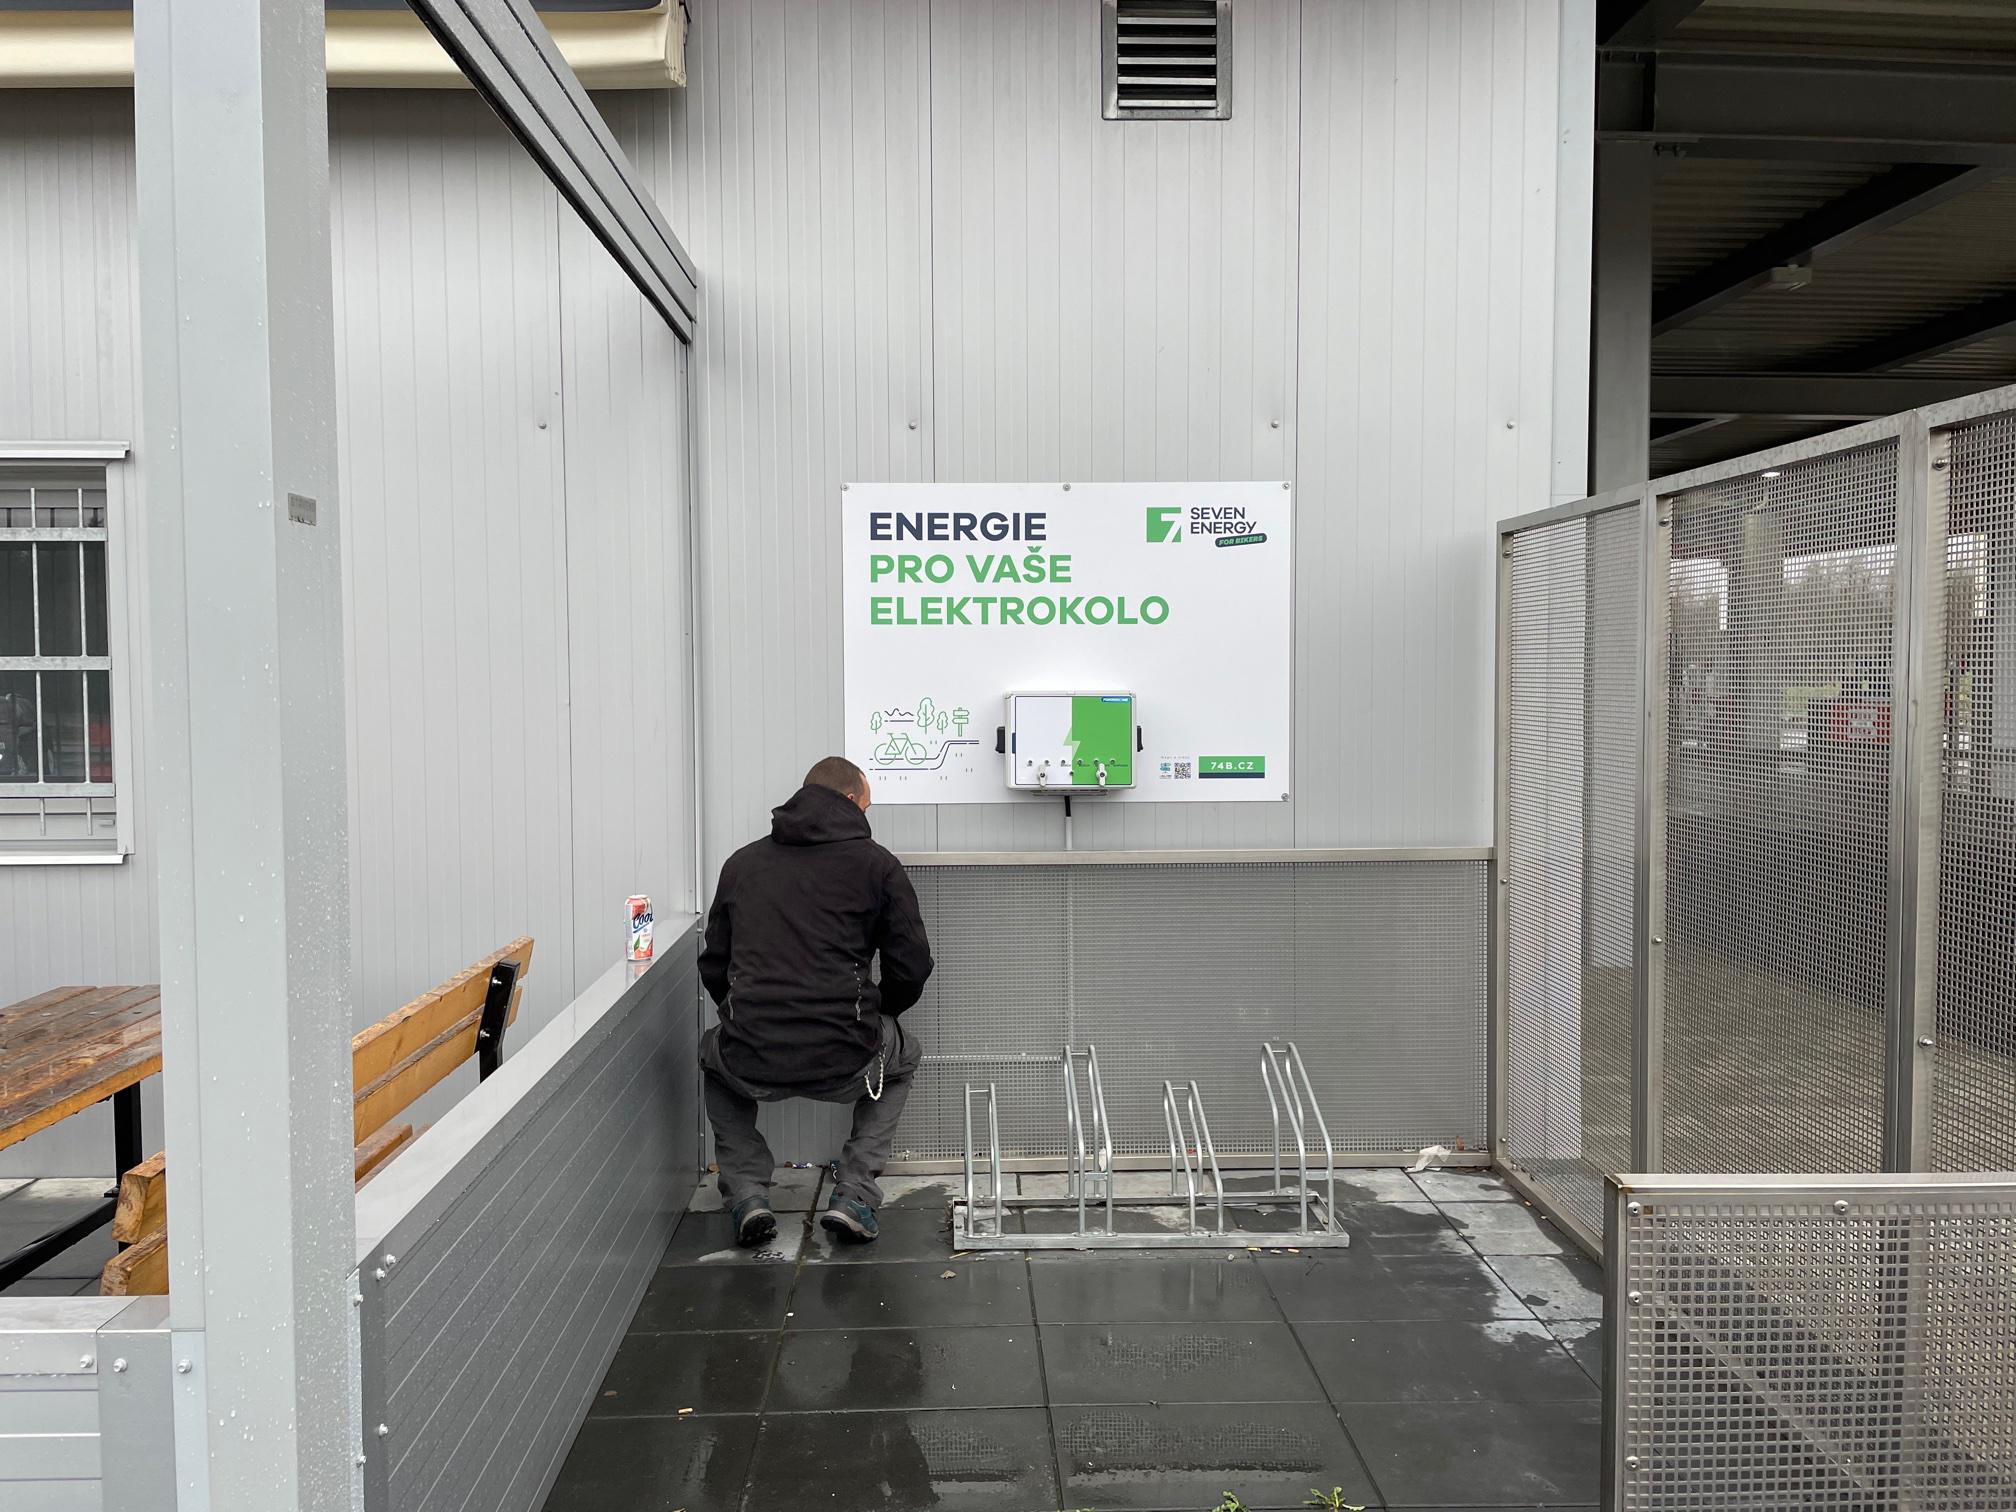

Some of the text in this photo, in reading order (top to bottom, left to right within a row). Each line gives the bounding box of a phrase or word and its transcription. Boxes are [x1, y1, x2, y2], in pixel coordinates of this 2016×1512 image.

[869, 511, 1047, 541] ENERGIE
[1190, 521, 1257, 535] ENERGY
[1218, 535, 1263, 547] FOR BIKERS
[870, 547, 1072, 584] PRO VAŠE
[870, 596, 1169, 625] ELEKTROKOLO
[1211, 761, 1254, 770] 74B.CZ
